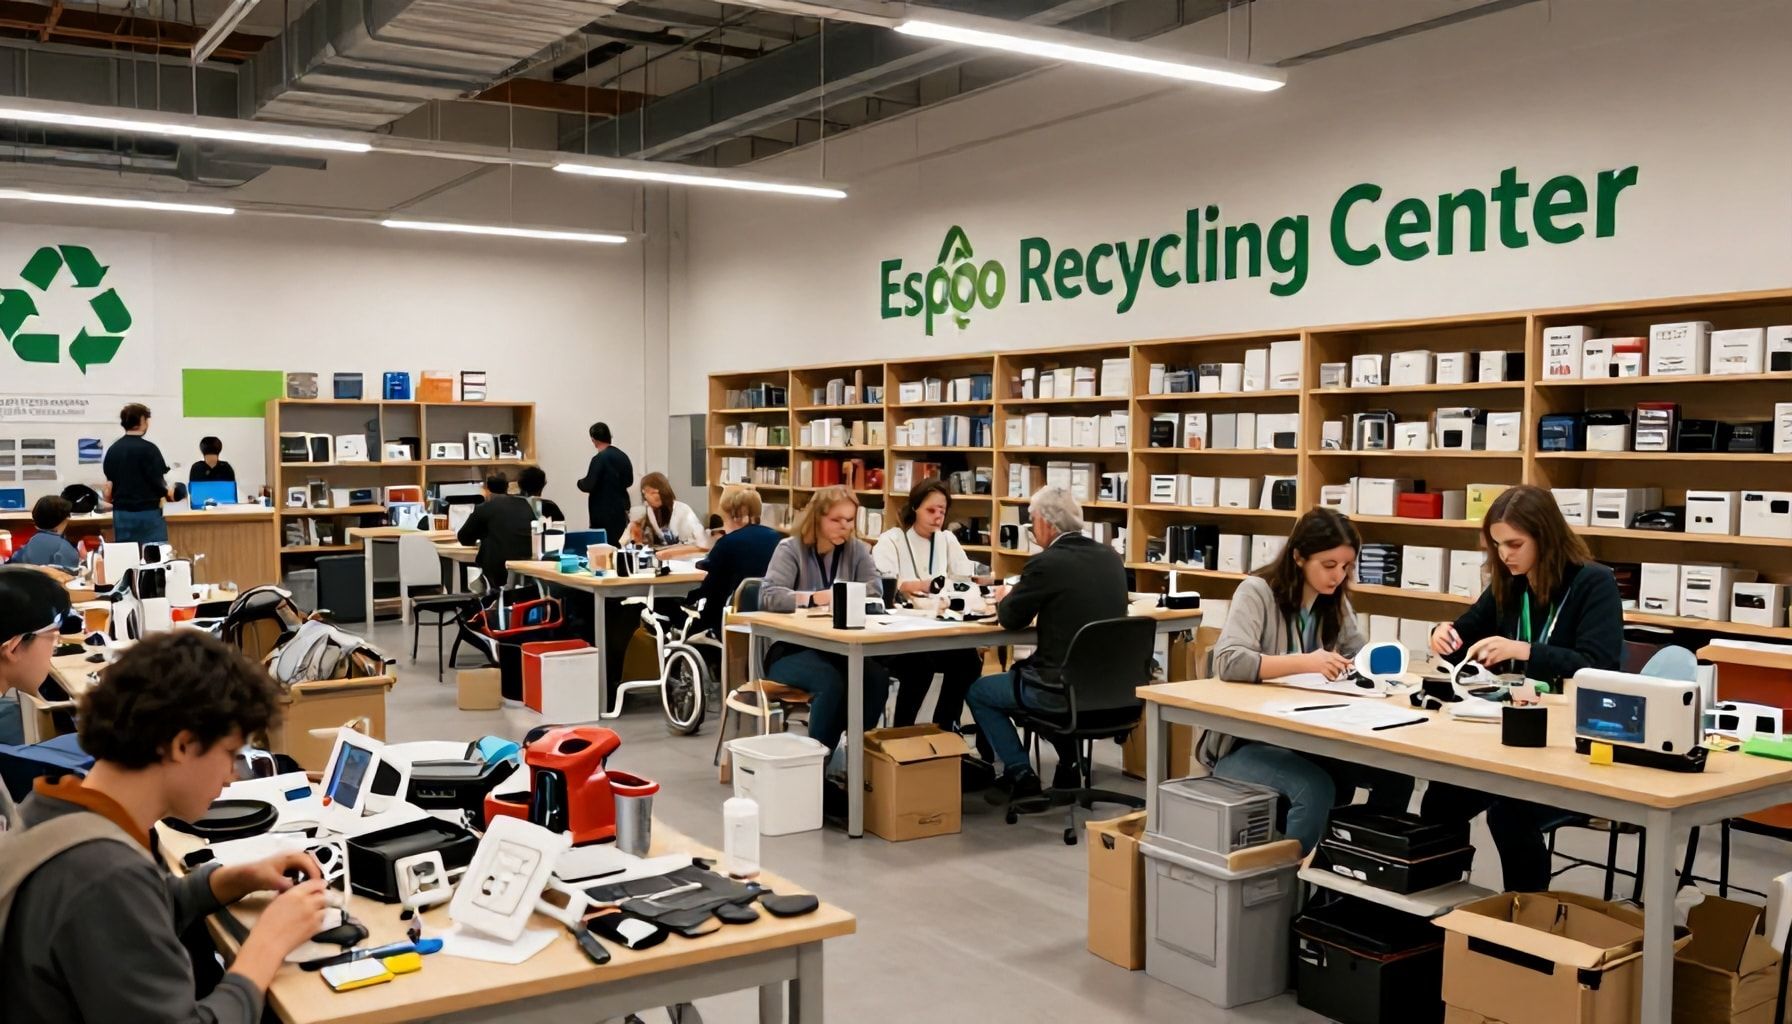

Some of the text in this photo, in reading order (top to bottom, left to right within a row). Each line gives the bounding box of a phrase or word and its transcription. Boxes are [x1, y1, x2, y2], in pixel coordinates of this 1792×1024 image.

[880, 165, 1639, 336] Espoo Recycling Center
